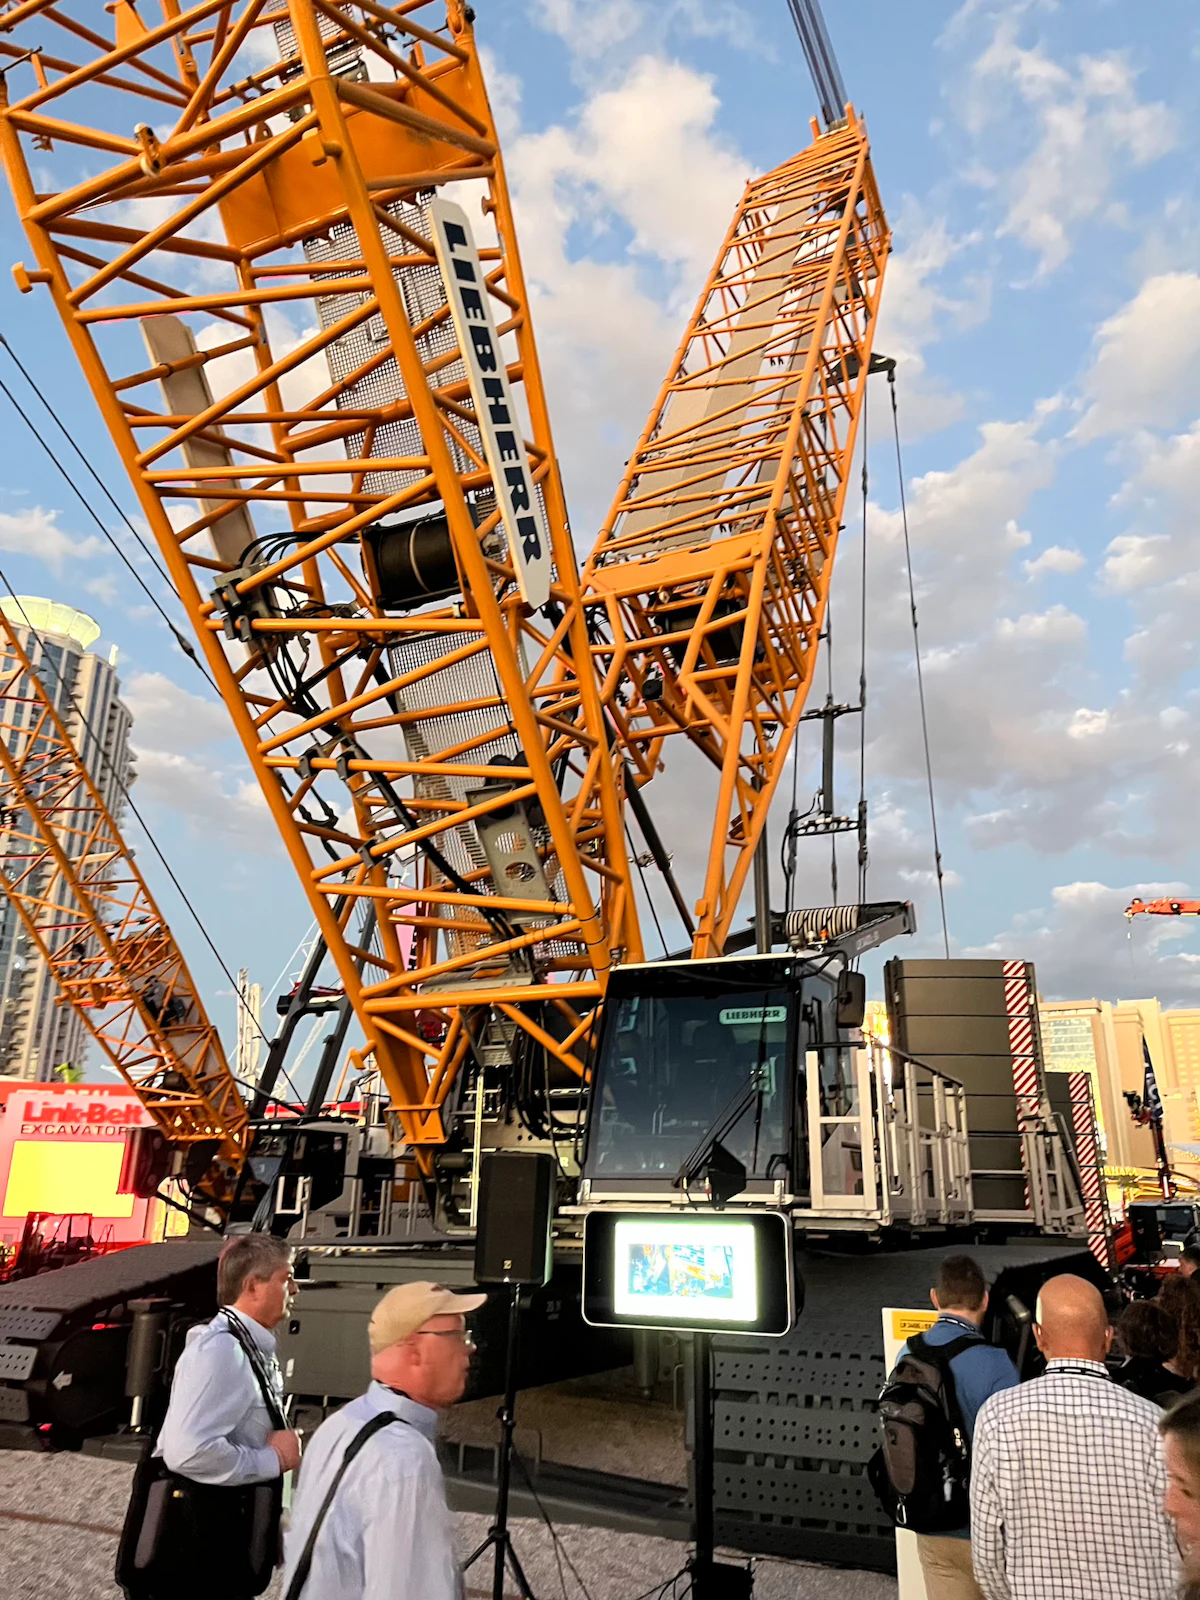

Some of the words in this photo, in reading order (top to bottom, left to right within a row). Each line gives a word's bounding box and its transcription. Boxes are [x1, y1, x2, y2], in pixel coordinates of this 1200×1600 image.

[443, 220, 542, 566] LIEBHERR
[725, 1009, 780, 1020] LIEBHERR
[23, 1101, 144, 1124] Link-Belt
